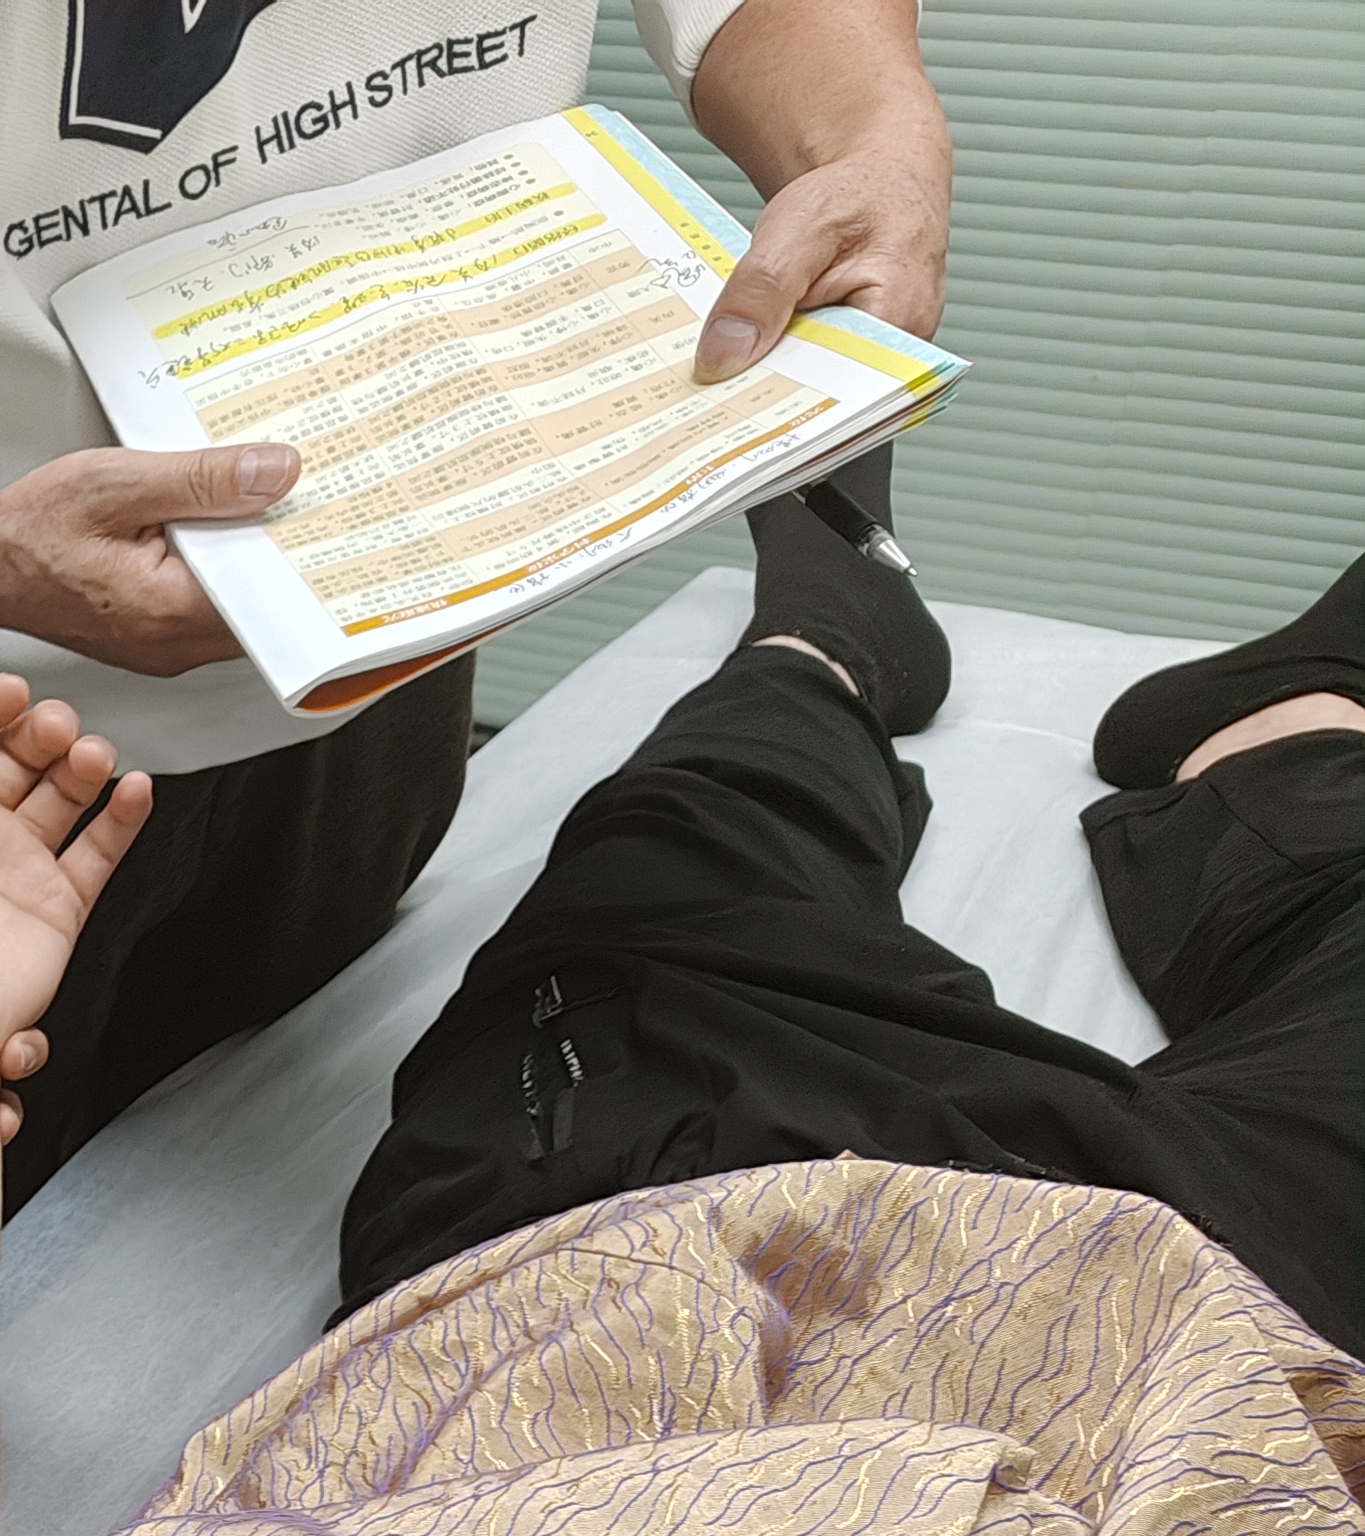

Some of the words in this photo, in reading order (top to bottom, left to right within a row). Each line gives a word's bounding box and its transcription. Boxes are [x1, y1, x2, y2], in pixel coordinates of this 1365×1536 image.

[2, 178, 172, 260] GENTAL
[178, 145, 240, 200] OF
[255, 82, 360, 165] HIGH
[366, 15, 538, 109] STREET
